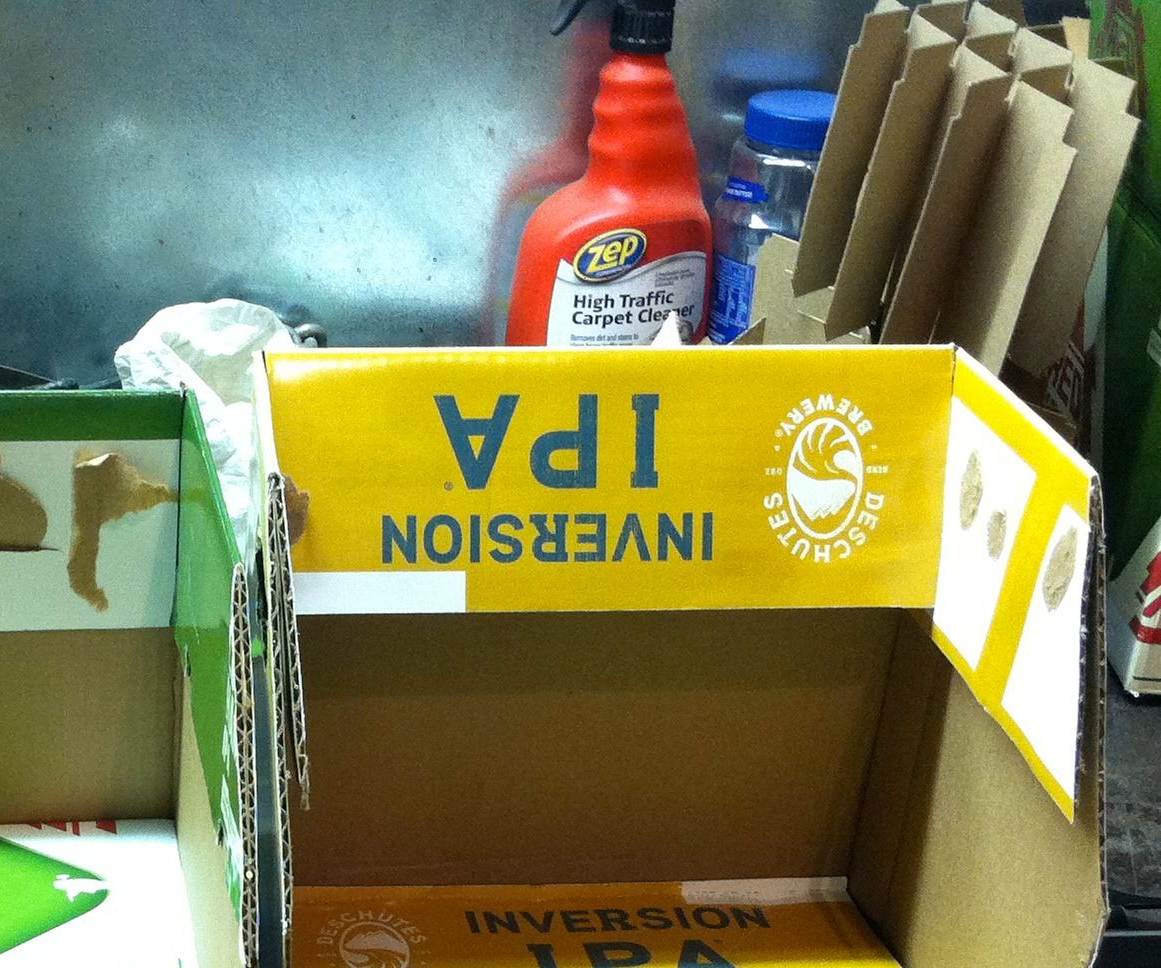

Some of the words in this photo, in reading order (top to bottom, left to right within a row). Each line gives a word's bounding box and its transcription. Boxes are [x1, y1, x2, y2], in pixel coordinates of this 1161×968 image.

[572, 310, 634, 329] Carpet
[573, 293, 615, 313] High
[619, 290, 675, 308] Traffic
[779, 393, 874, 437] BREWERY
[432, 393, 660, 490] IPA
[380, 512, 714, 565] INVERSION
[763, 492, 886, 564] DESCHUTES
[316, 910, 428, 945] DESCHUTES
[464, 905, 772, 934] INVERSION
